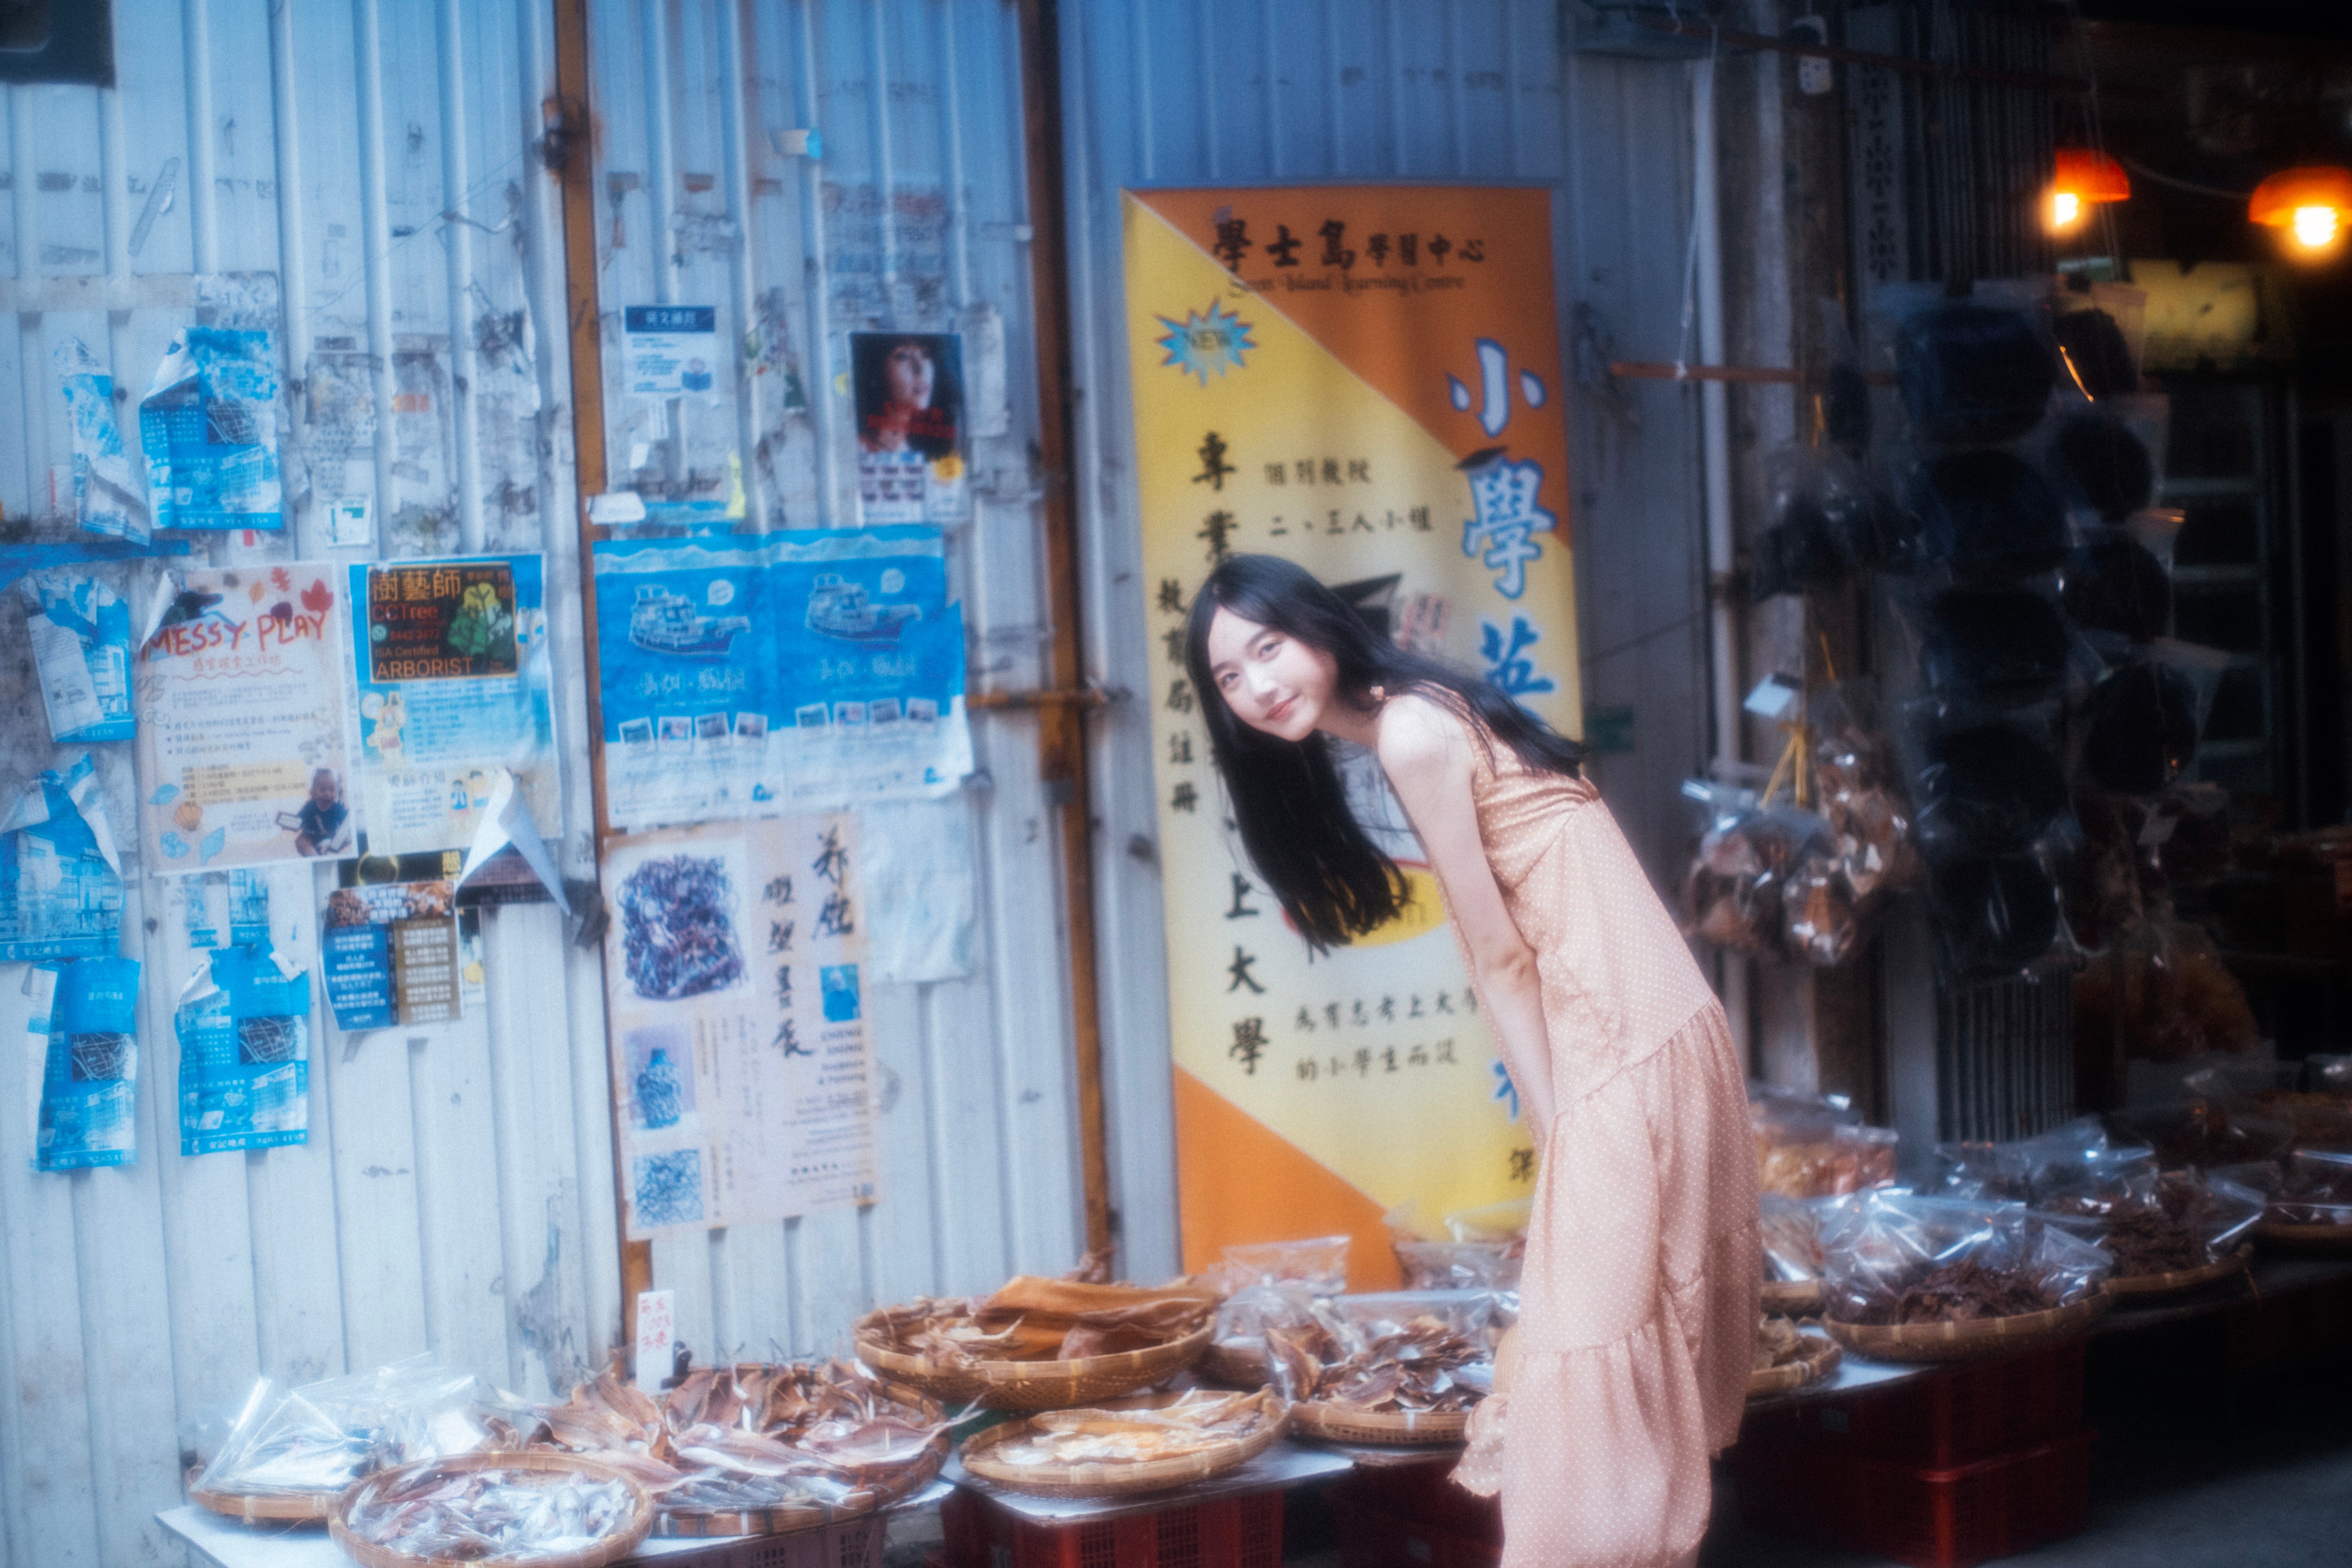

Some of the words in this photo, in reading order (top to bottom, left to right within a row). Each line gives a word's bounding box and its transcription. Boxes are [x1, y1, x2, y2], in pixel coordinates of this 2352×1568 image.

[371, 568, 461, 602] 樹藝師
[140, 621, 248, 662] MESSY
[257, 610, 328, 652] PLAY
[376, 657, 473, 679] ARBORIST
